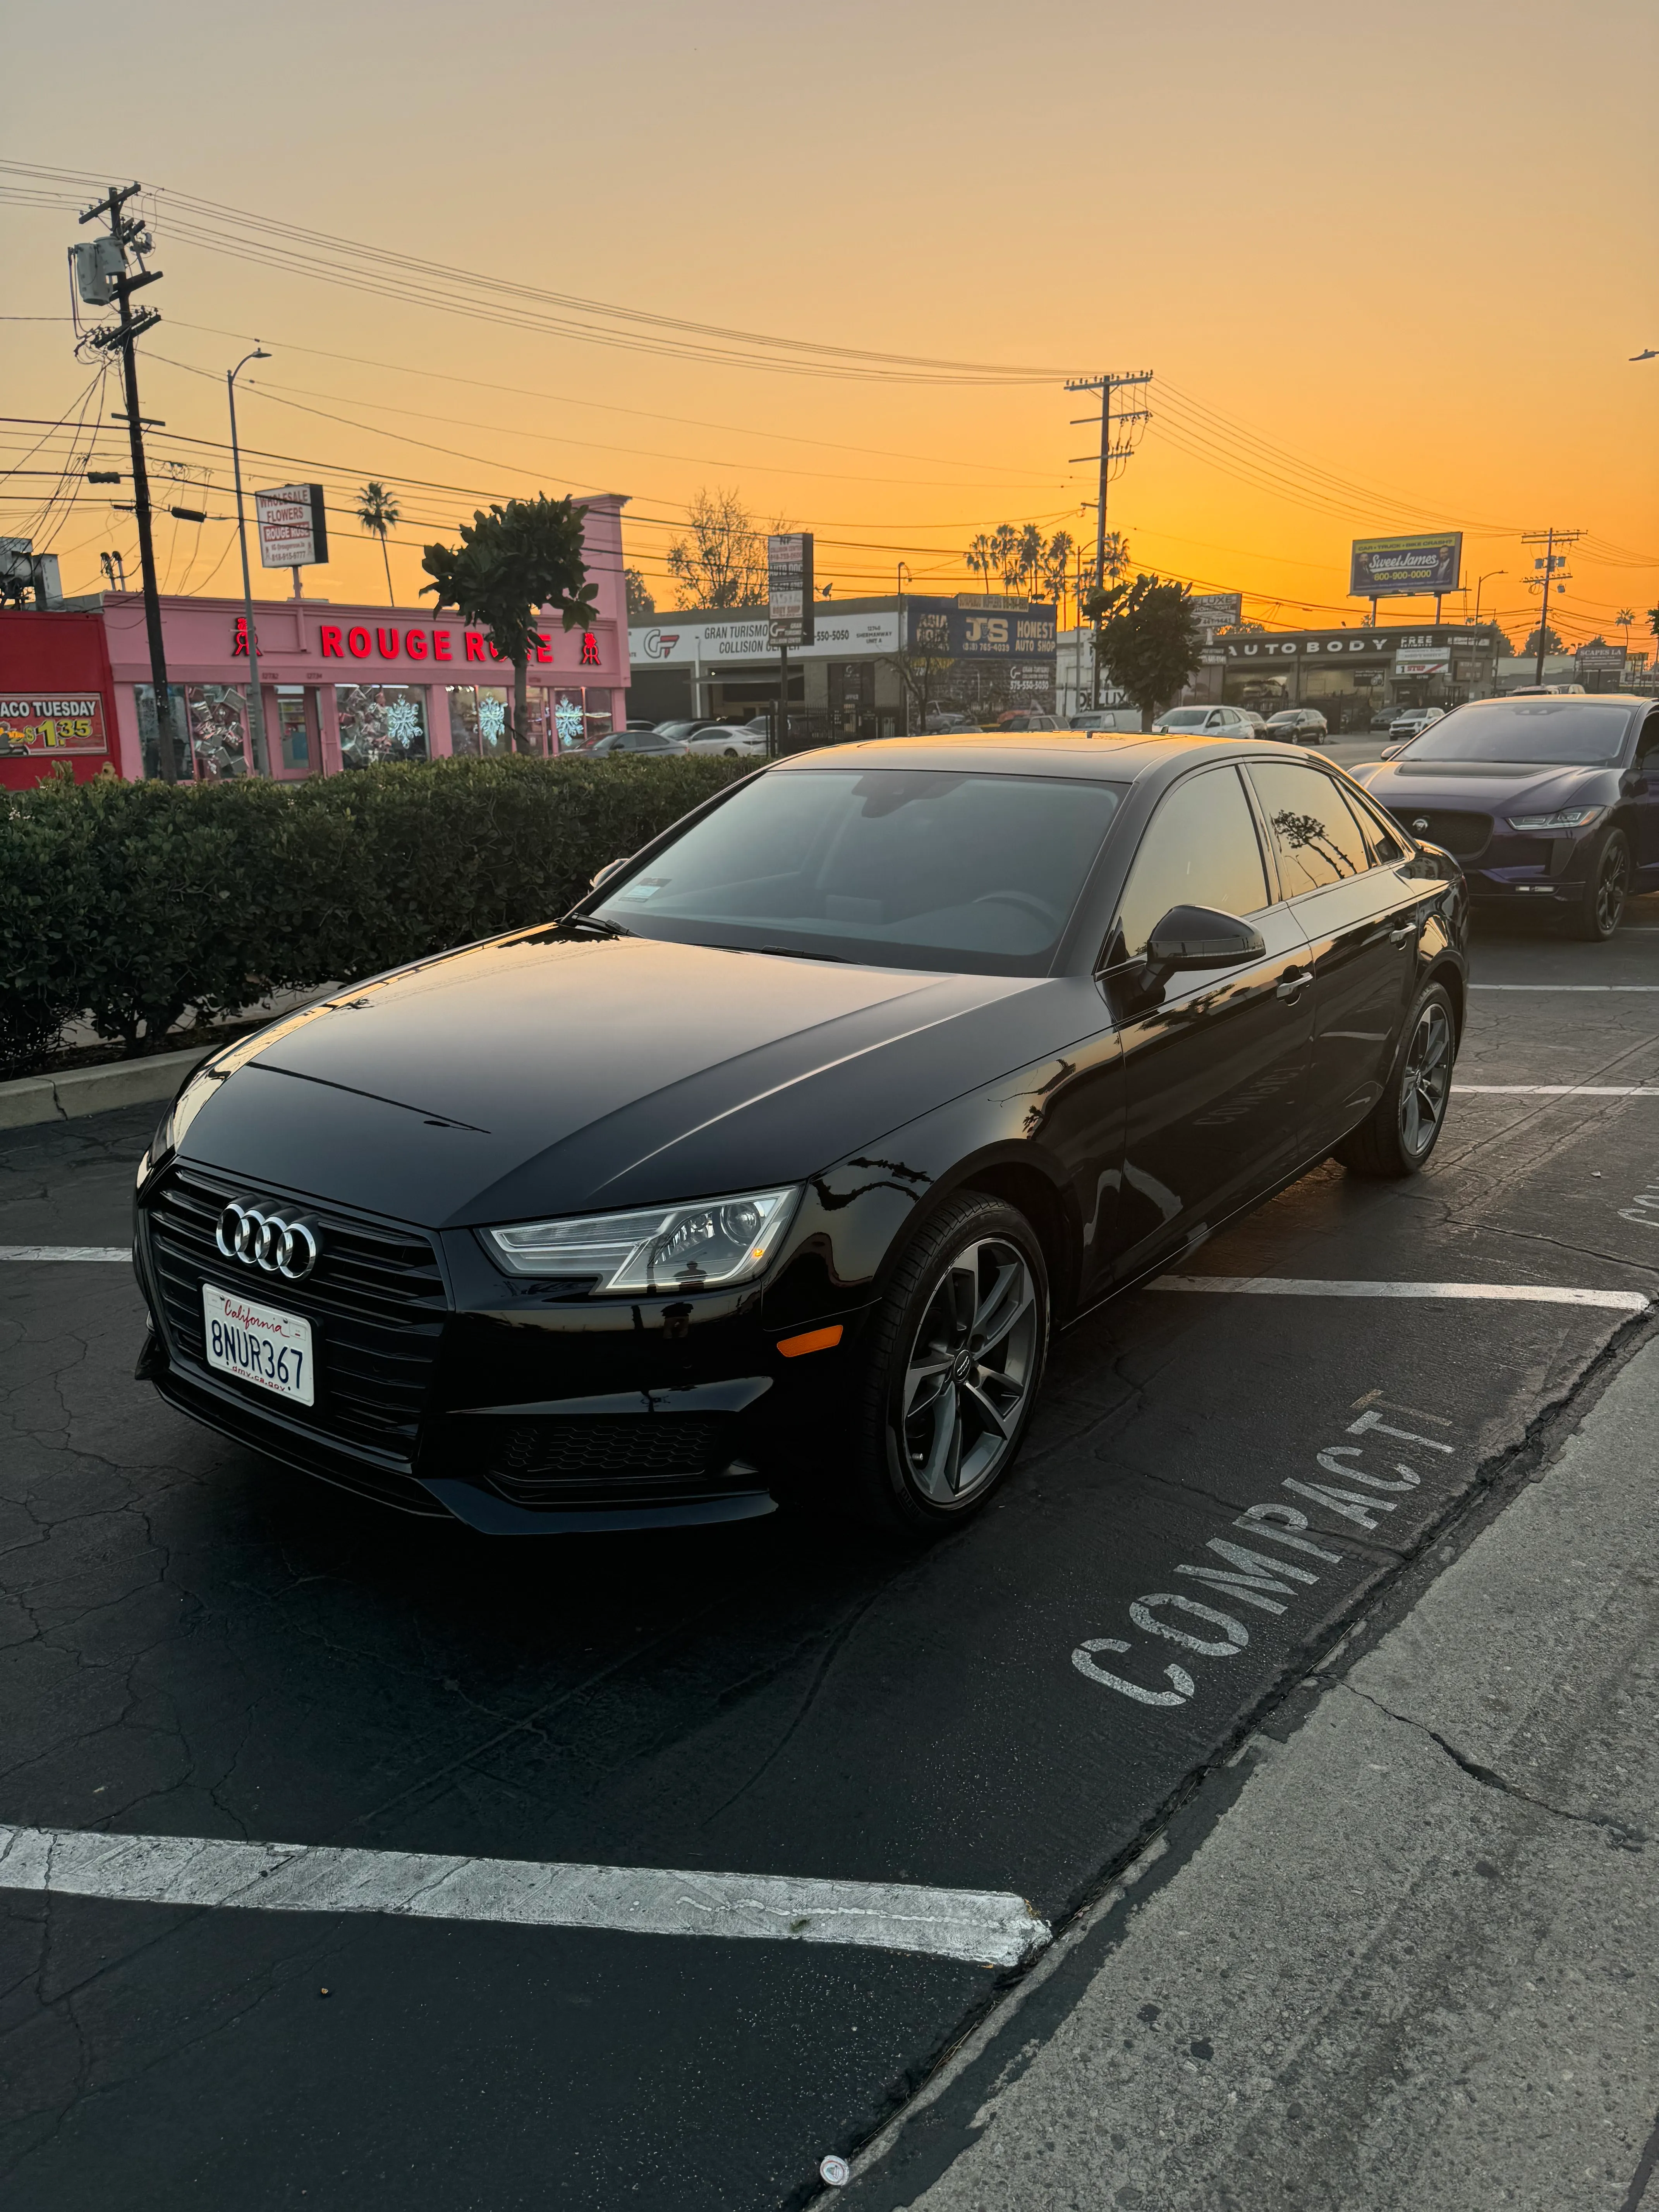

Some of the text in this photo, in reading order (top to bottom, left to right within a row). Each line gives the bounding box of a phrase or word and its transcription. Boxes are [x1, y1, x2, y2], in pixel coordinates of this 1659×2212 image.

[260, 490, 308, 508] WHOLESALE
[267, 507, 304, 523] FLOWERS
[266, 527, 290, 541] ROUGE
[1373, 570, 1432, 581] 800-900-0000
[1194, 596, 1232, 605] ELUXE
[705, 624, 768, 639] GRAN TURISMO
[814, 630, 849, 641] -550-5050
[1017, 620, 1054, 639] HONEST
[321, 625, 453, 661] ROUGE
[465, 632, 554, 663] RE
[719, 640, 764, 654] COLLISION
[1015, 640, 1056, 652] AUTO SHOP
[1228, 643, 1297, 656] AUTO
[1307, 639, 1388, 653] BODY
[1401, 635, 1432, 644] FREE
[0, 701, 96, 717] ACO TUESDAY
[24, 719, 93, 748] $1.35
[225, 1299, 290, 1338] California
[211, 1319, 303, 1389] 8NUR367
[232, 1365, 285, 1392] dmv.ca.gov
[1071, 1410, 1454, 1706] COMPACT
